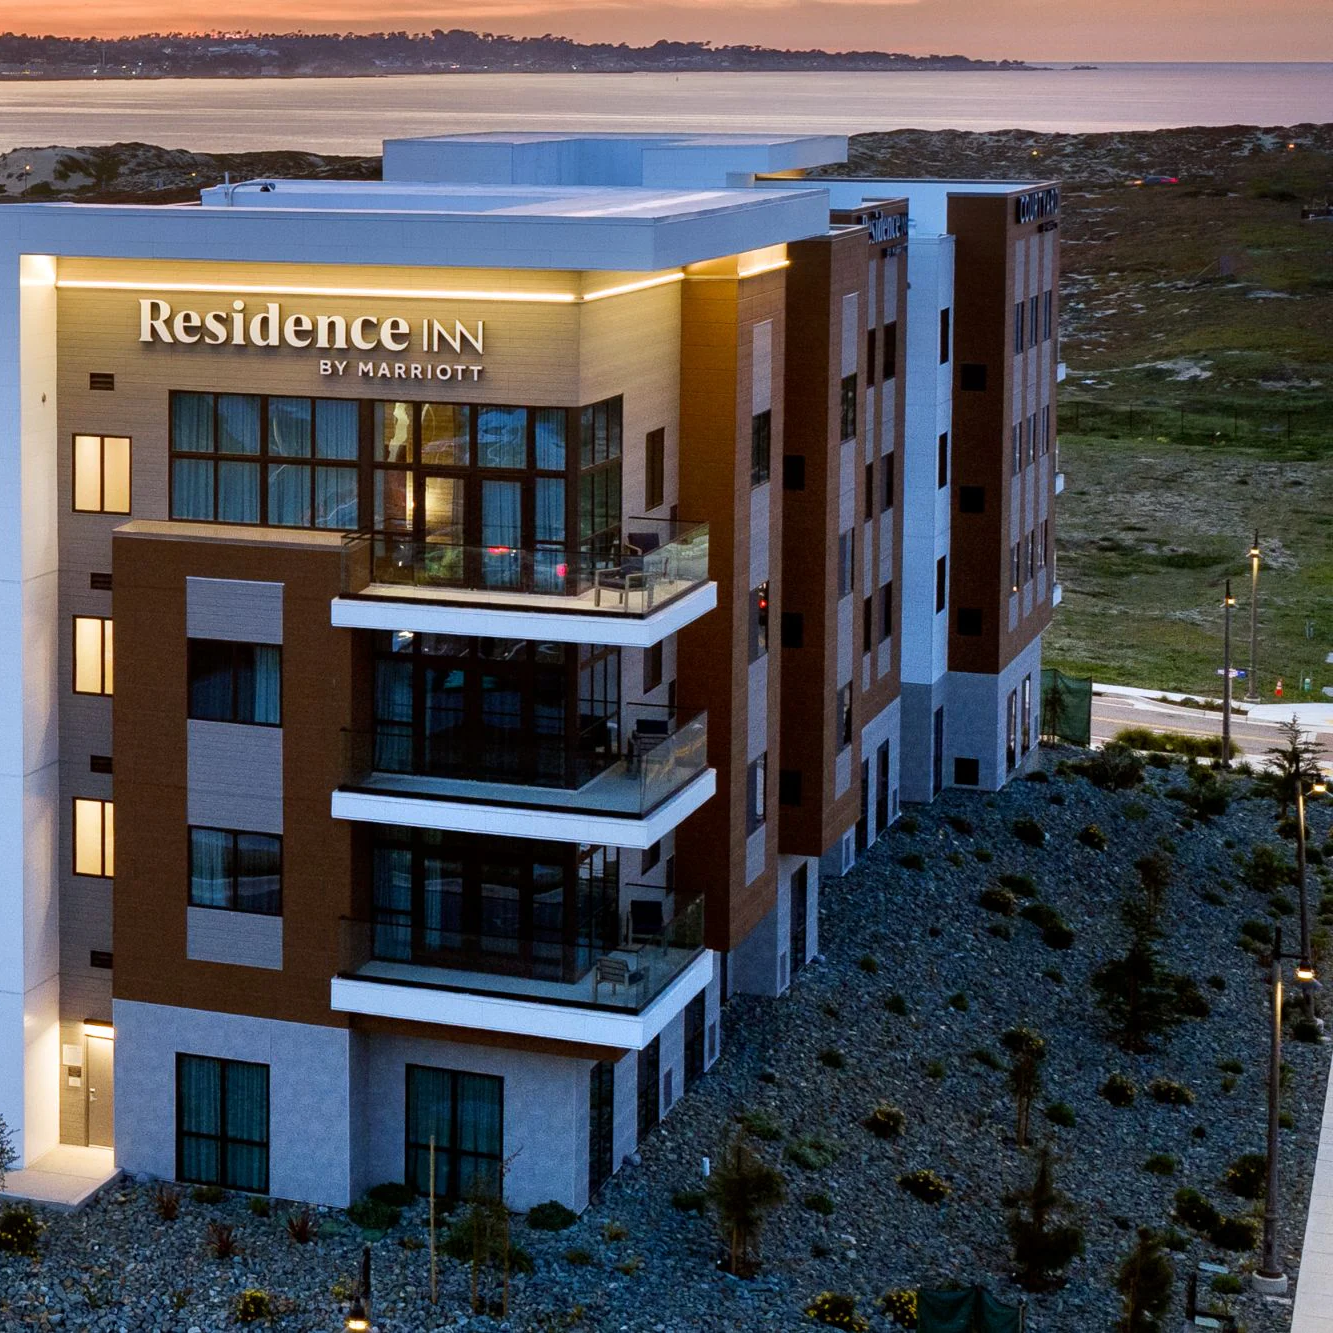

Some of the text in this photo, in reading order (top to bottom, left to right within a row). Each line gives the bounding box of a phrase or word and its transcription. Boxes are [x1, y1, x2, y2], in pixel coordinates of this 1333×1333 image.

[139, 299, 485, 354] Residence INN
[319, 360, 483, 381] BY MARRIOTT
